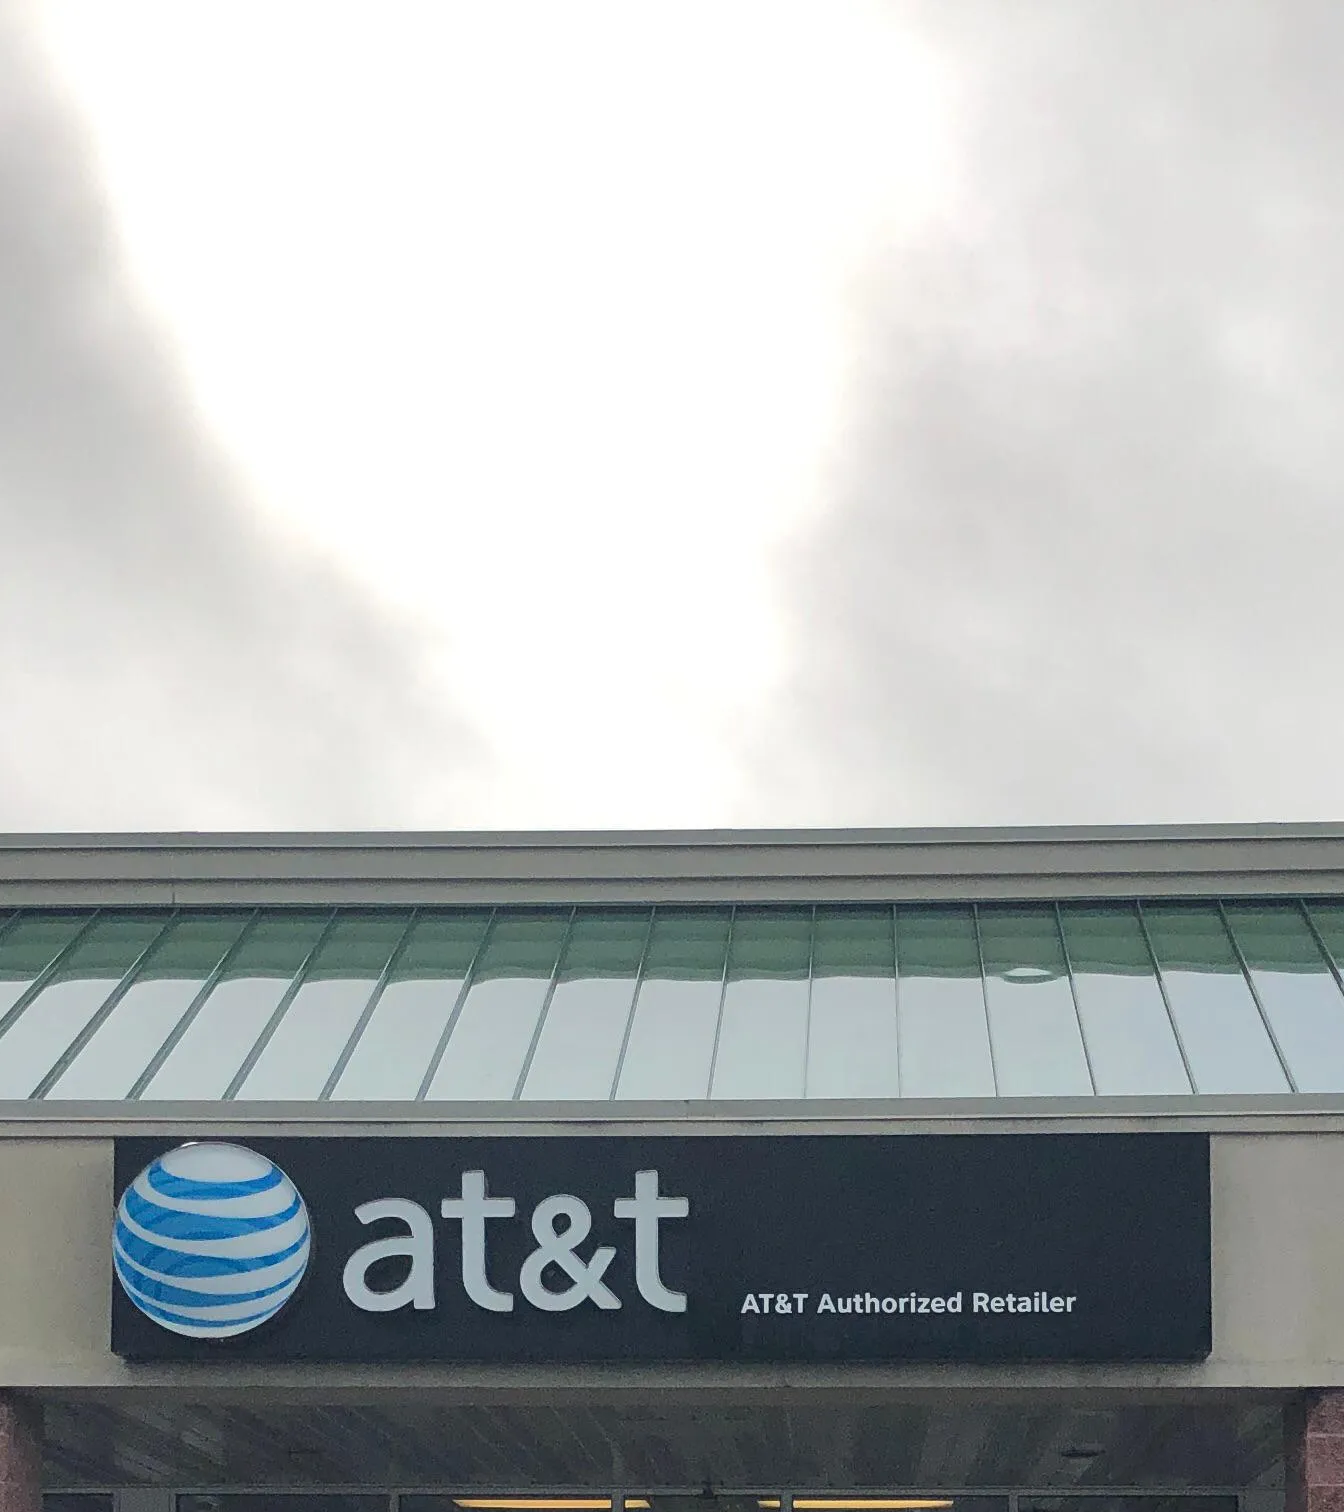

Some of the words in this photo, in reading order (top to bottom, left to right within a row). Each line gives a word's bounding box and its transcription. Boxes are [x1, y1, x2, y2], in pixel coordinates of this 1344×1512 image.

[343, 1169, 689, 1313] at&t
[741, 1294, 808, 1314] AT&T
[817, 1293, 962, 1314] Authorized
[972, 1293, 1076, 1314] Retailer
